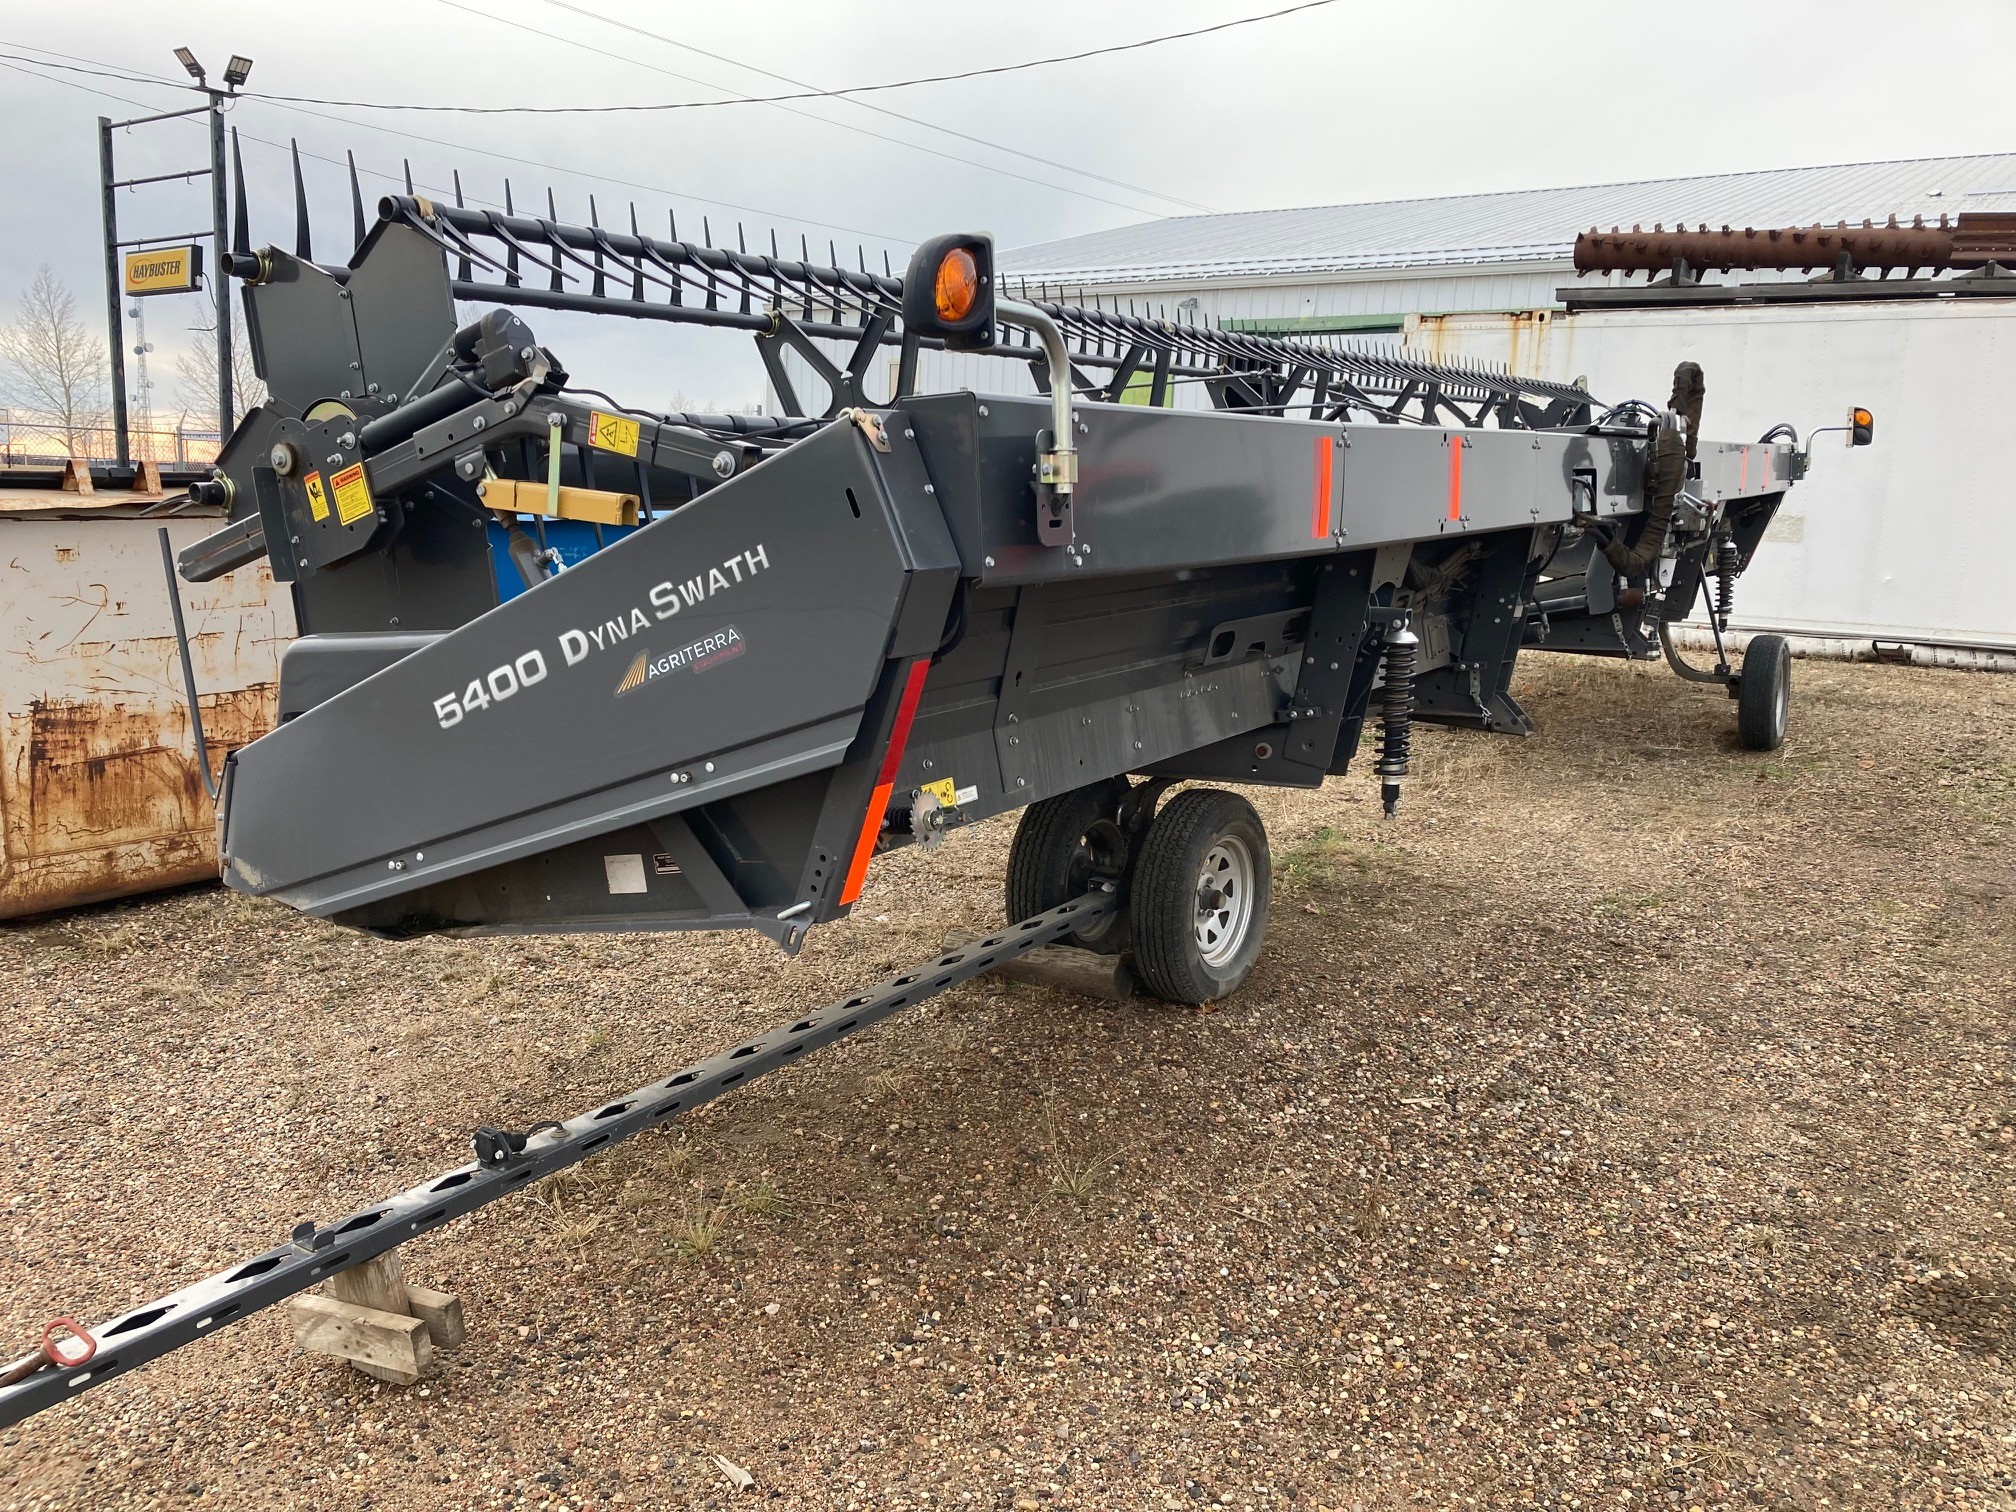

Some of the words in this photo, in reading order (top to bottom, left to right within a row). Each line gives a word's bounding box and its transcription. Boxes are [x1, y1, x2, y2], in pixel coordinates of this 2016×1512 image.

[133, 261, 181, 279] HAYBUSTER
[340, 471, 360, 483] WARNING
[648, 628, 741, 679] AGRITERRA
[694, 643, 744, 670] EQUIPMENT
[433, 649, 548, 730] 5400
